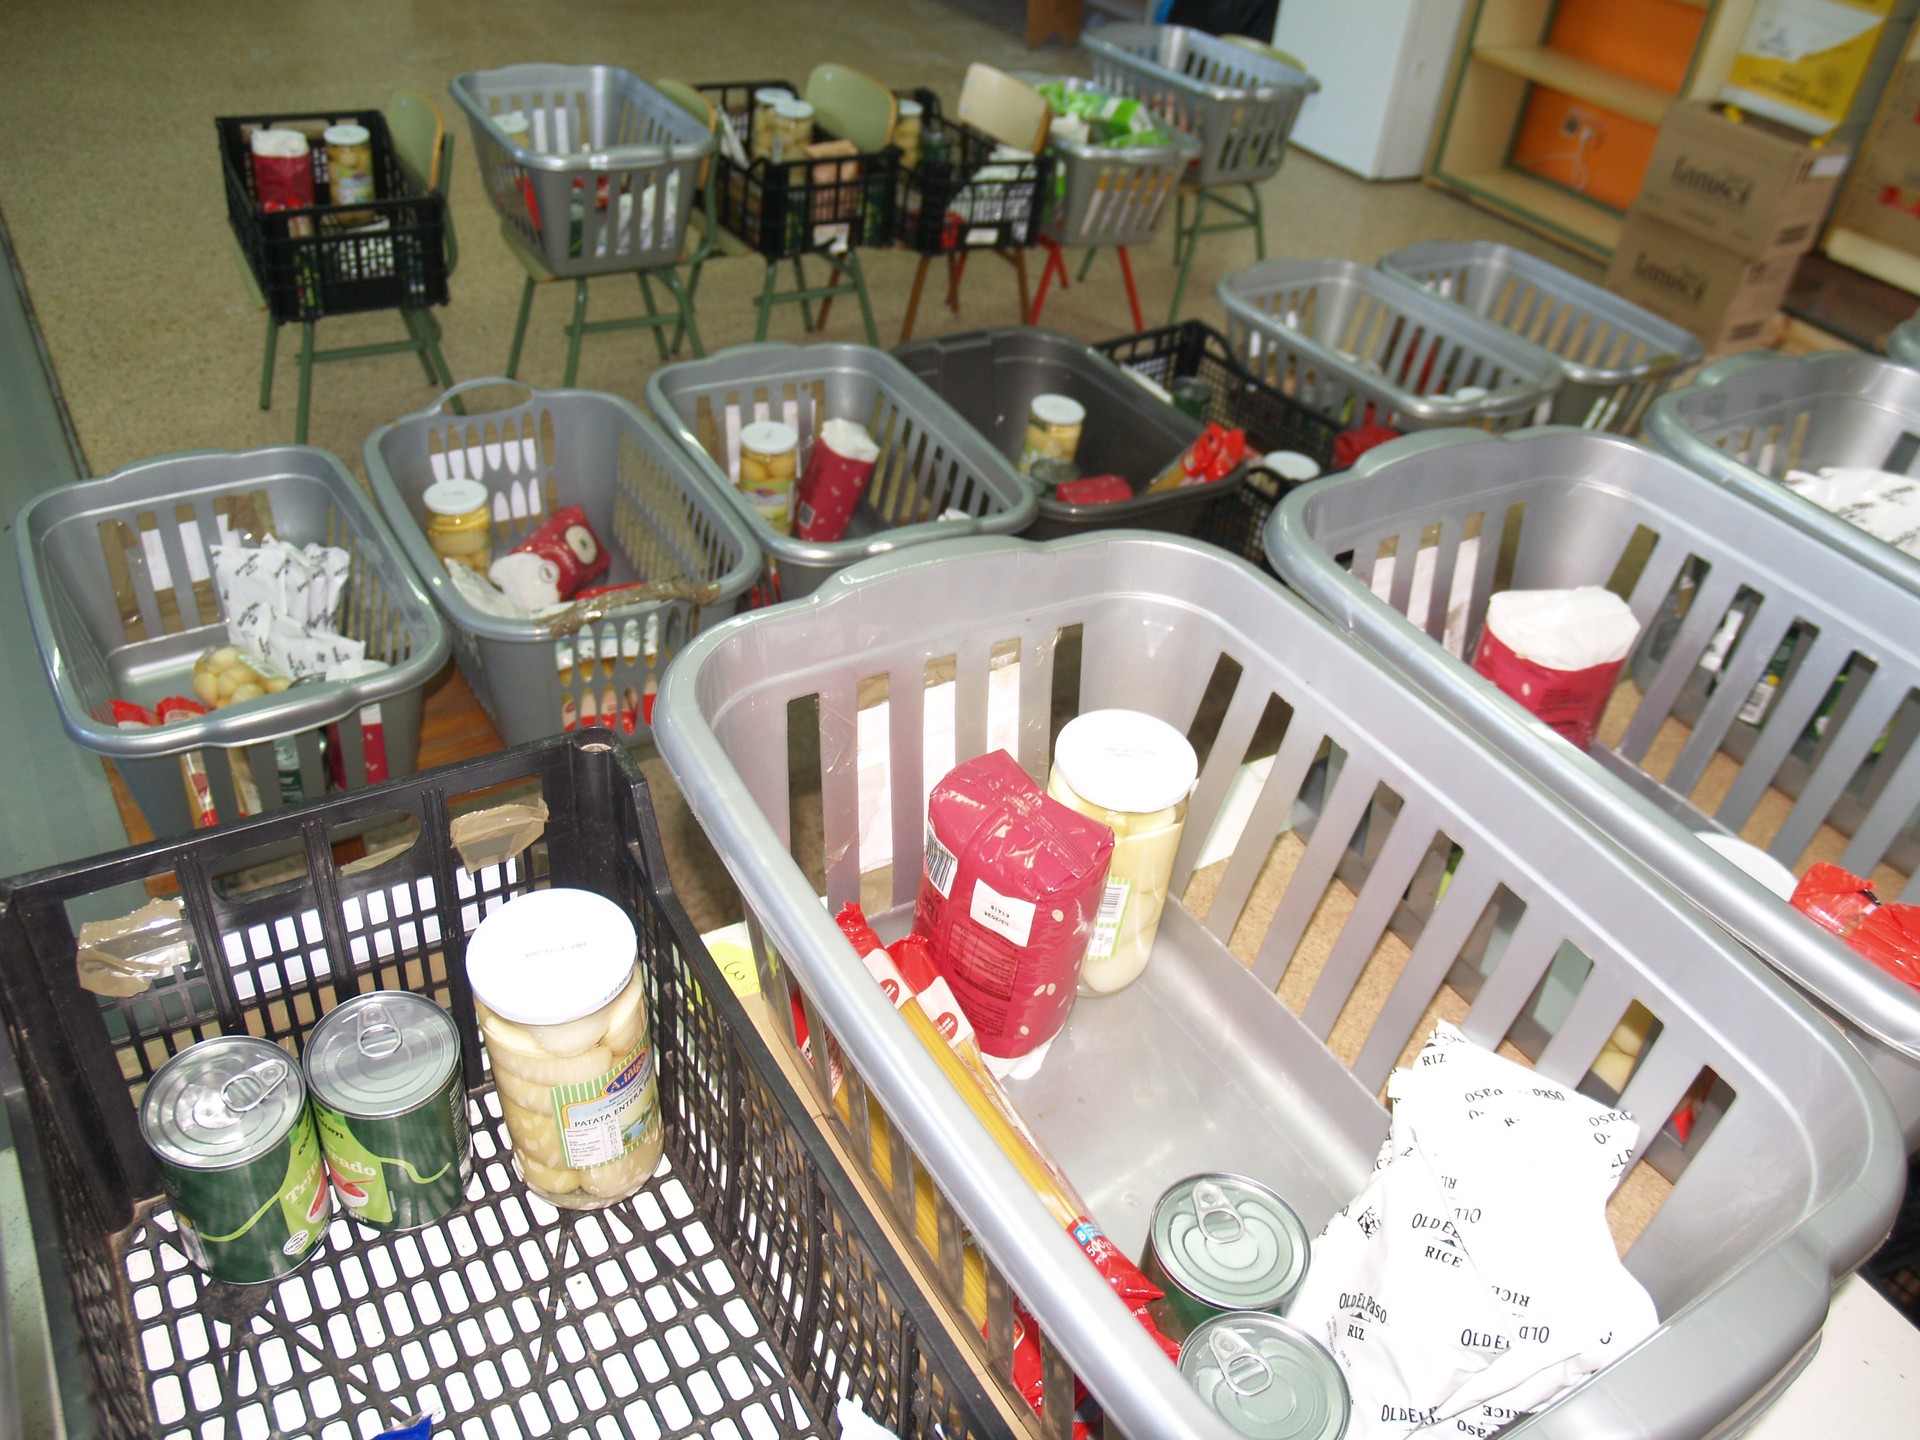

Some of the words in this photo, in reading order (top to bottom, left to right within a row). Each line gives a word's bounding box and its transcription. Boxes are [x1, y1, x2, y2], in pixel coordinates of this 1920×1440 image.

[1422, 1053, 1447, 1067] RIZ
[574, 1113, 611, 1128] PATATA
[614, 1088, 644, 1115] ENTERA
[1425, 1245, 1463, 1268] RICE
[1347, 1324, 1364, 1341] RIZ
